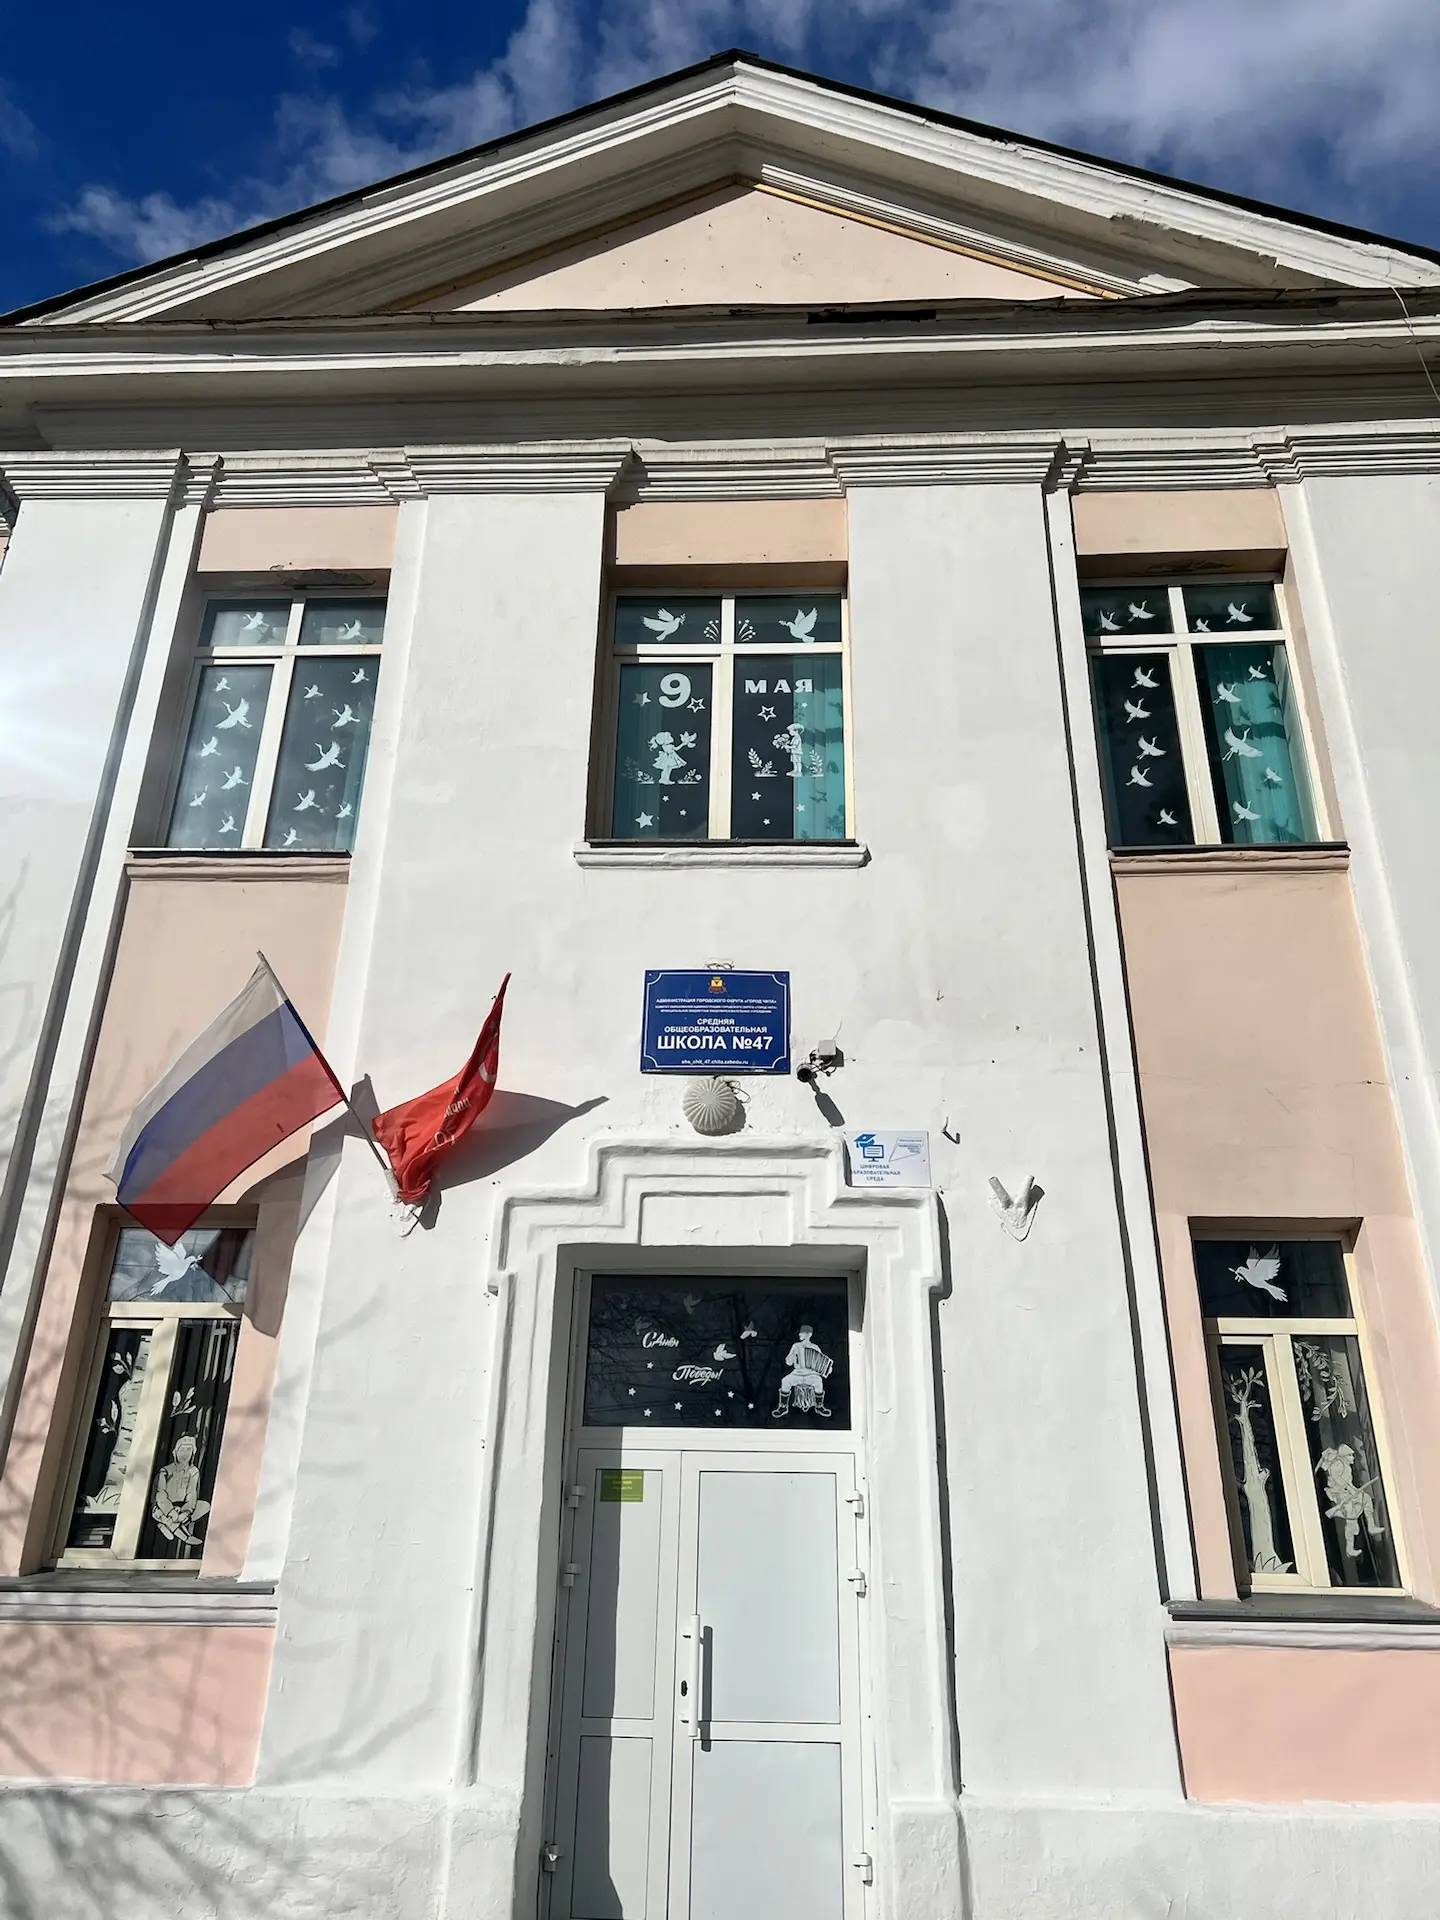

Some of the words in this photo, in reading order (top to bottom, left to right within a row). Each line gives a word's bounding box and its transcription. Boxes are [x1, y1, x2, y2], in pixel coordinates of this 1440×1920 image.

[658, 672, 692, 708] 9
[744, 678, 813, 694] МАЯ
[697, 1018, 735, 1026] СРЕДНЯЯ
[657, 1035, 727, 1050] ШКОЛА
[732, 1035, 774, 1050] №47
